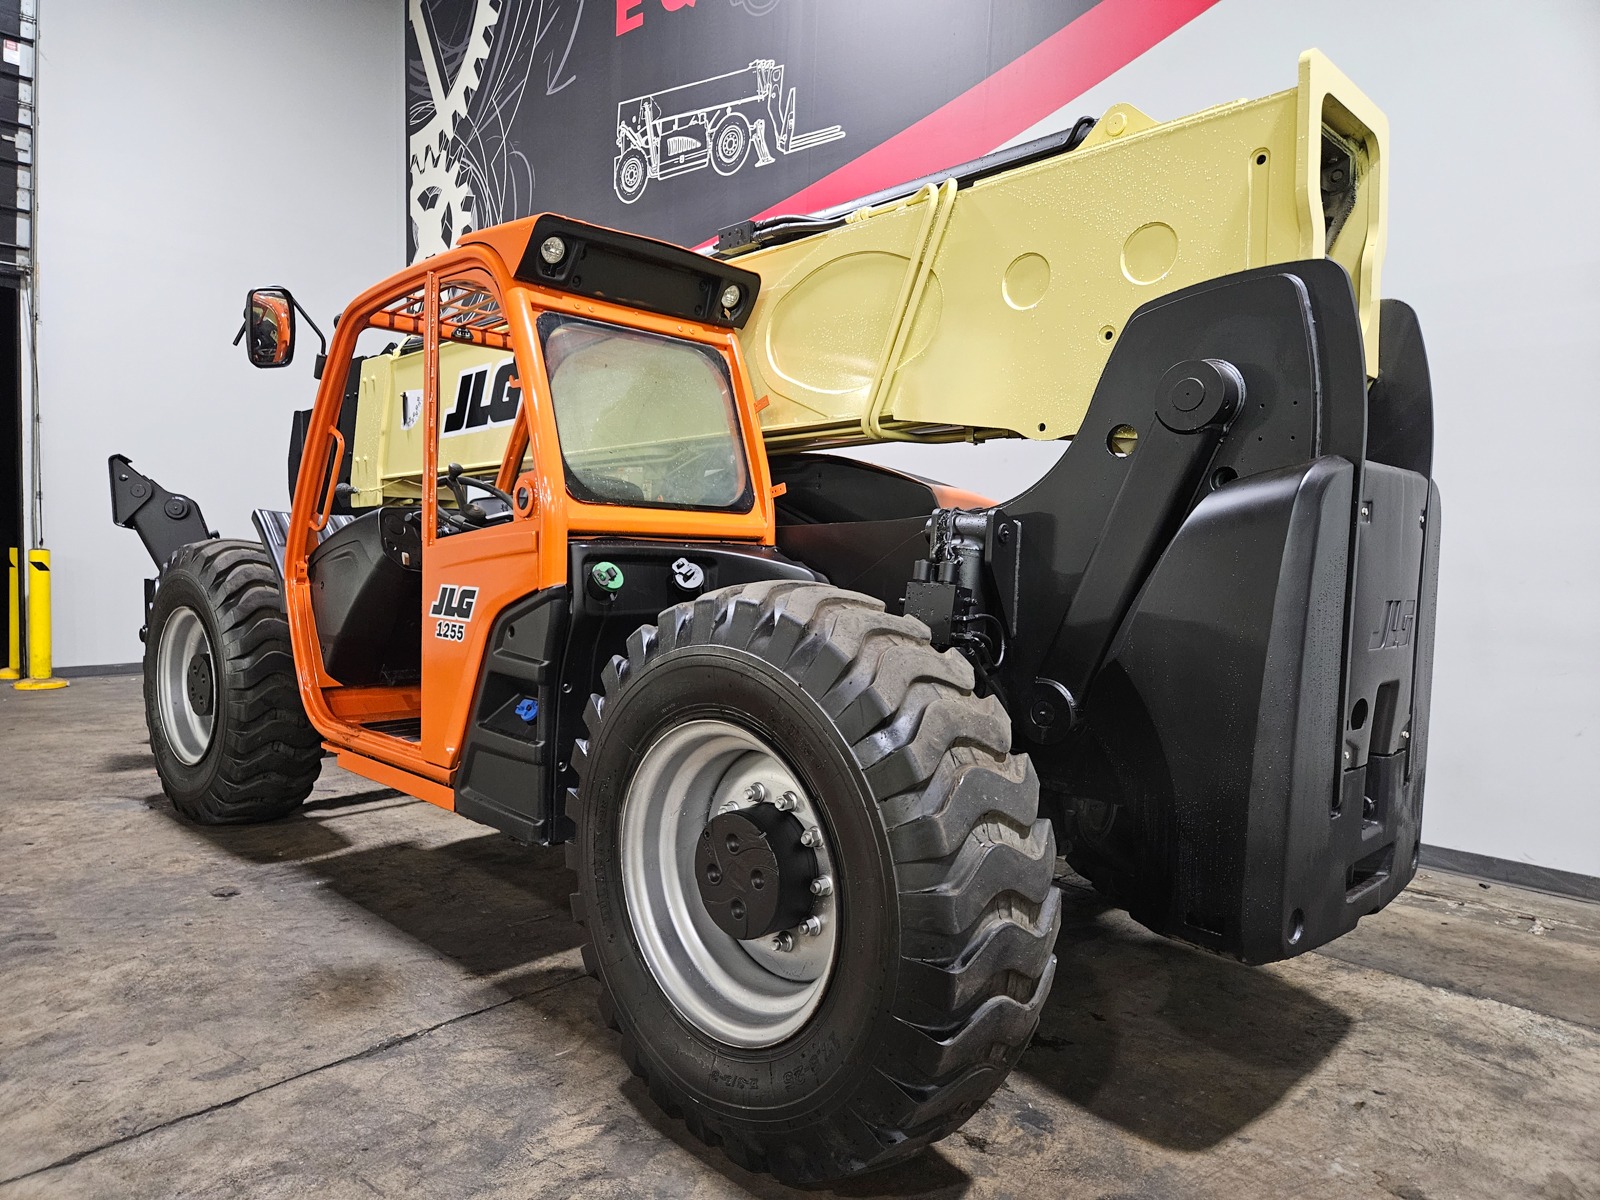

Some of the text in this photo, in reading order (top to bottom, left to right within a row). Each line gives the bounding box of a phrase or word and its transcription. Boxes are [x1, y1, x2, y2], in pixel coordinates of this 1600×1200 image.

[444, 356, 521, 433] JLG
[432, 587, 477, 619] JLG
[436, 622, 464, 641] 1255
[1368, 600, 1415, 651] JLG
